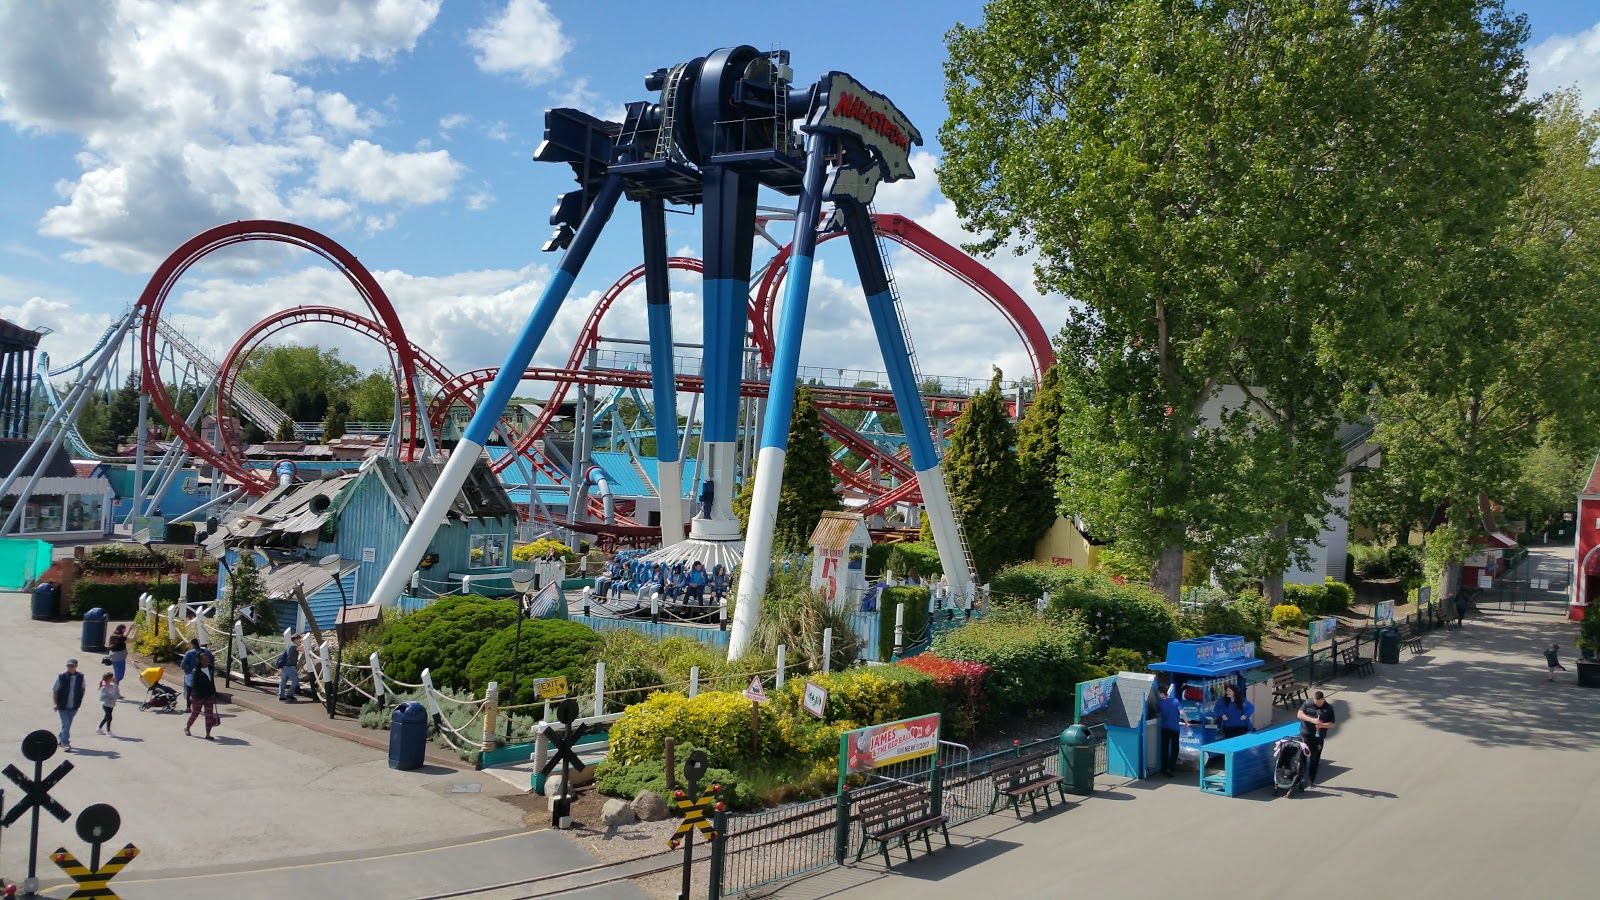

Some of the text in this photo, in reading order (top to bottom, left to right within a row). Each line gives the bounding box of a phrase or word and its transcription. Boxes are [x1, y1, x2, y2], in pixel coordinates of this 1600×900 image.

[833, 91, 909, 151] MAELSTROM
[541, 680, 558, 689] EXIT
[870, 728, 896, 751] JAMES
